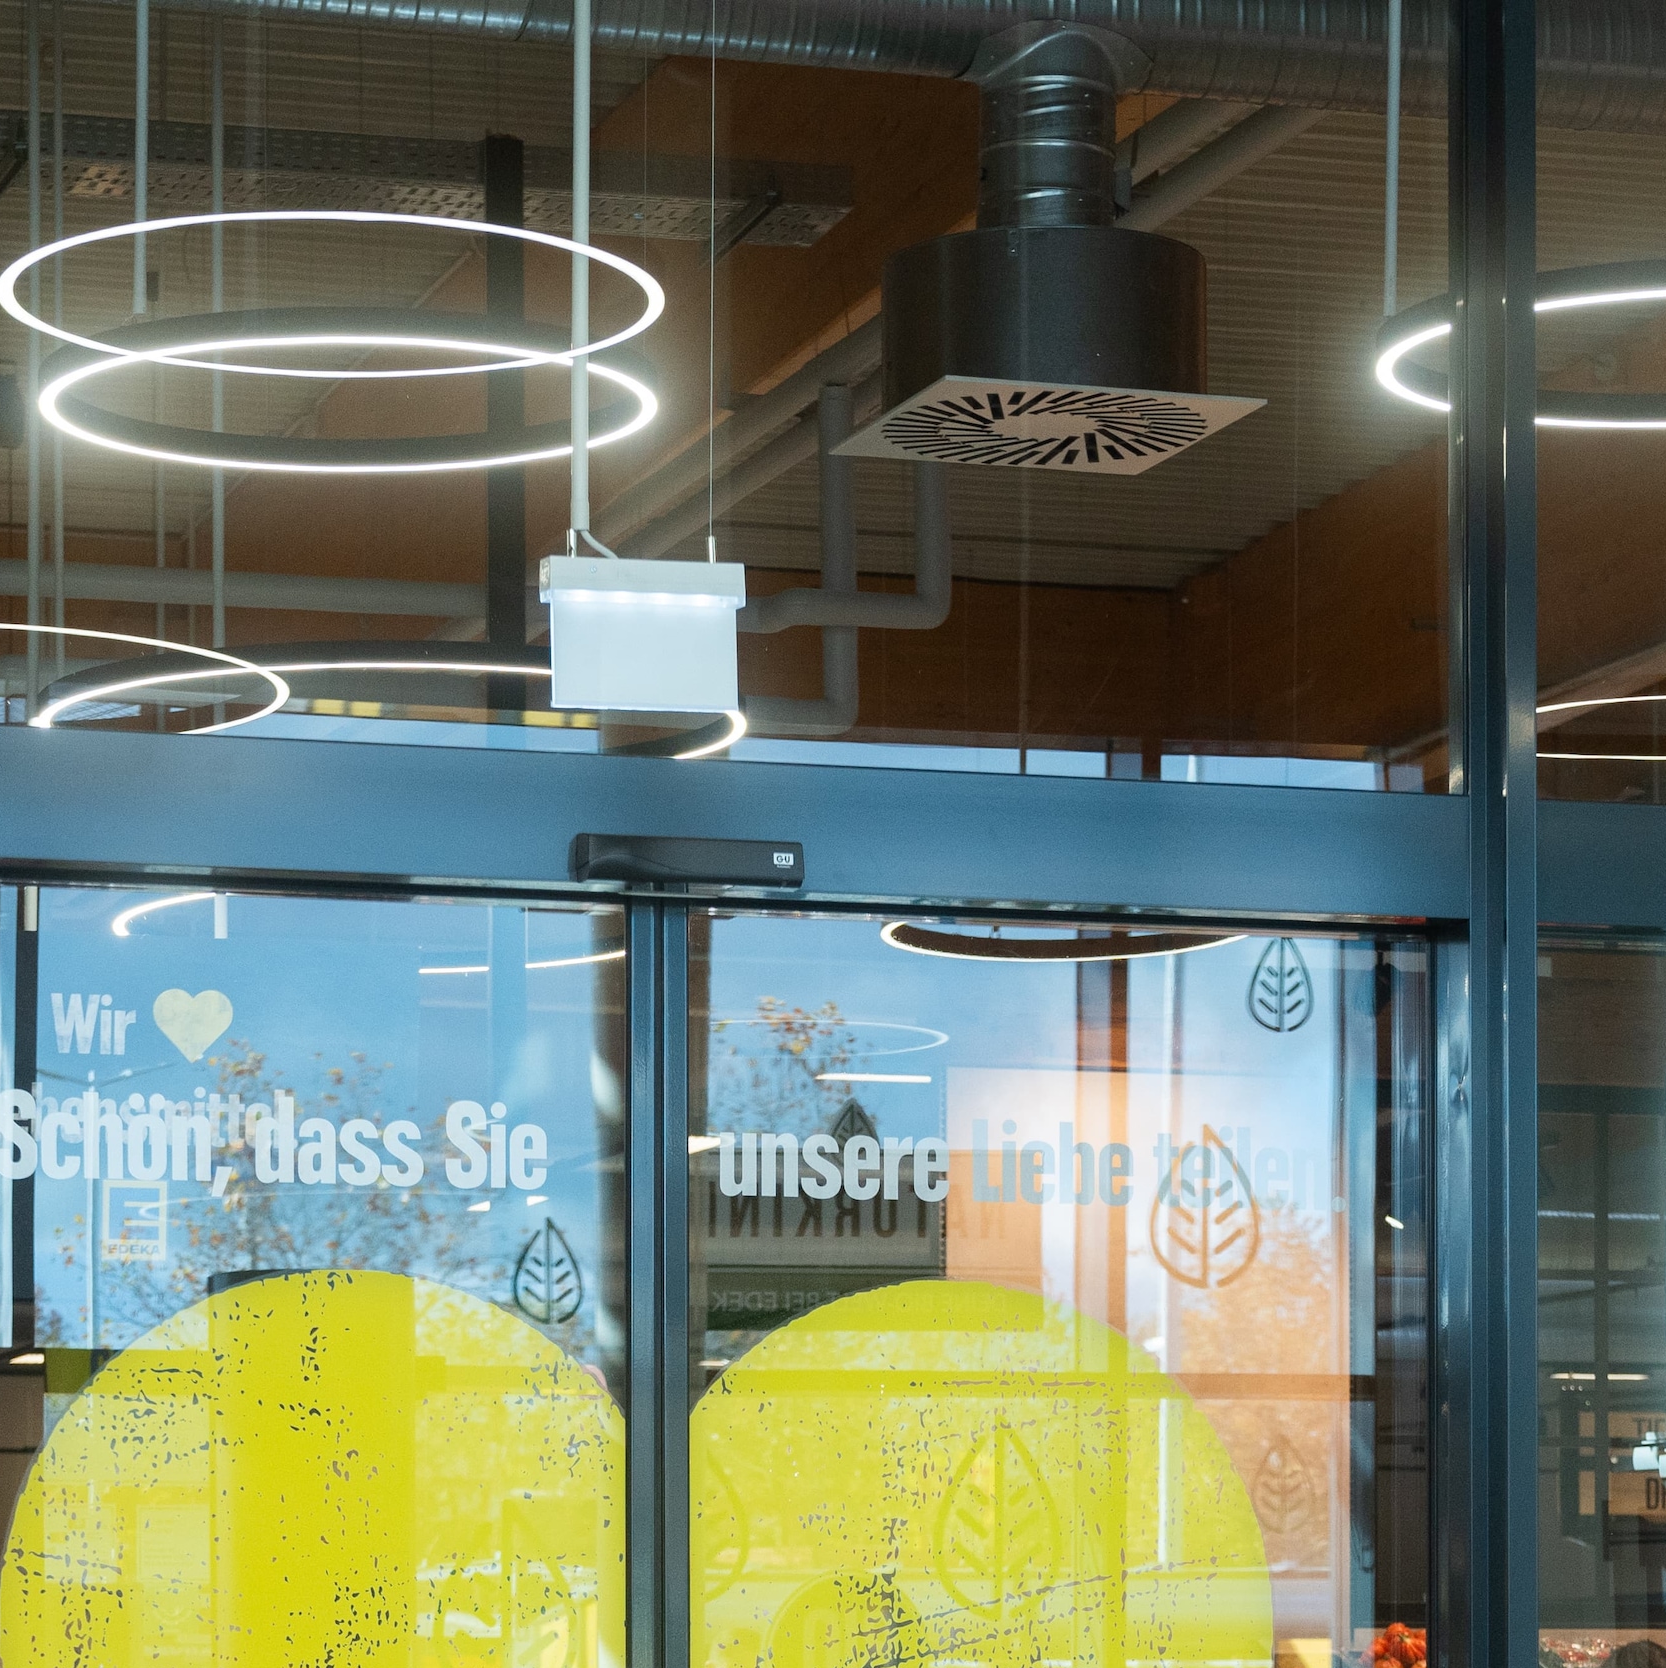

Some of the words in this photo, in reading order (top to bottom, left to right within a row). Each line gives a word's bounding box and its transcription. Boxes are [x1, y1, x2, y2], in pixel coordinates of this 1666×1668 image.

[50, 992, 137, 1056] Wir
[254, 1090, 424, 1187] dass
[445, 1101, 548, 1191] Sie
[718, 1130, 950, 1203] unsere
[972, 1118, 1135, 1208] Liebe
[107, 1243, 161, 1256] EDEKA
